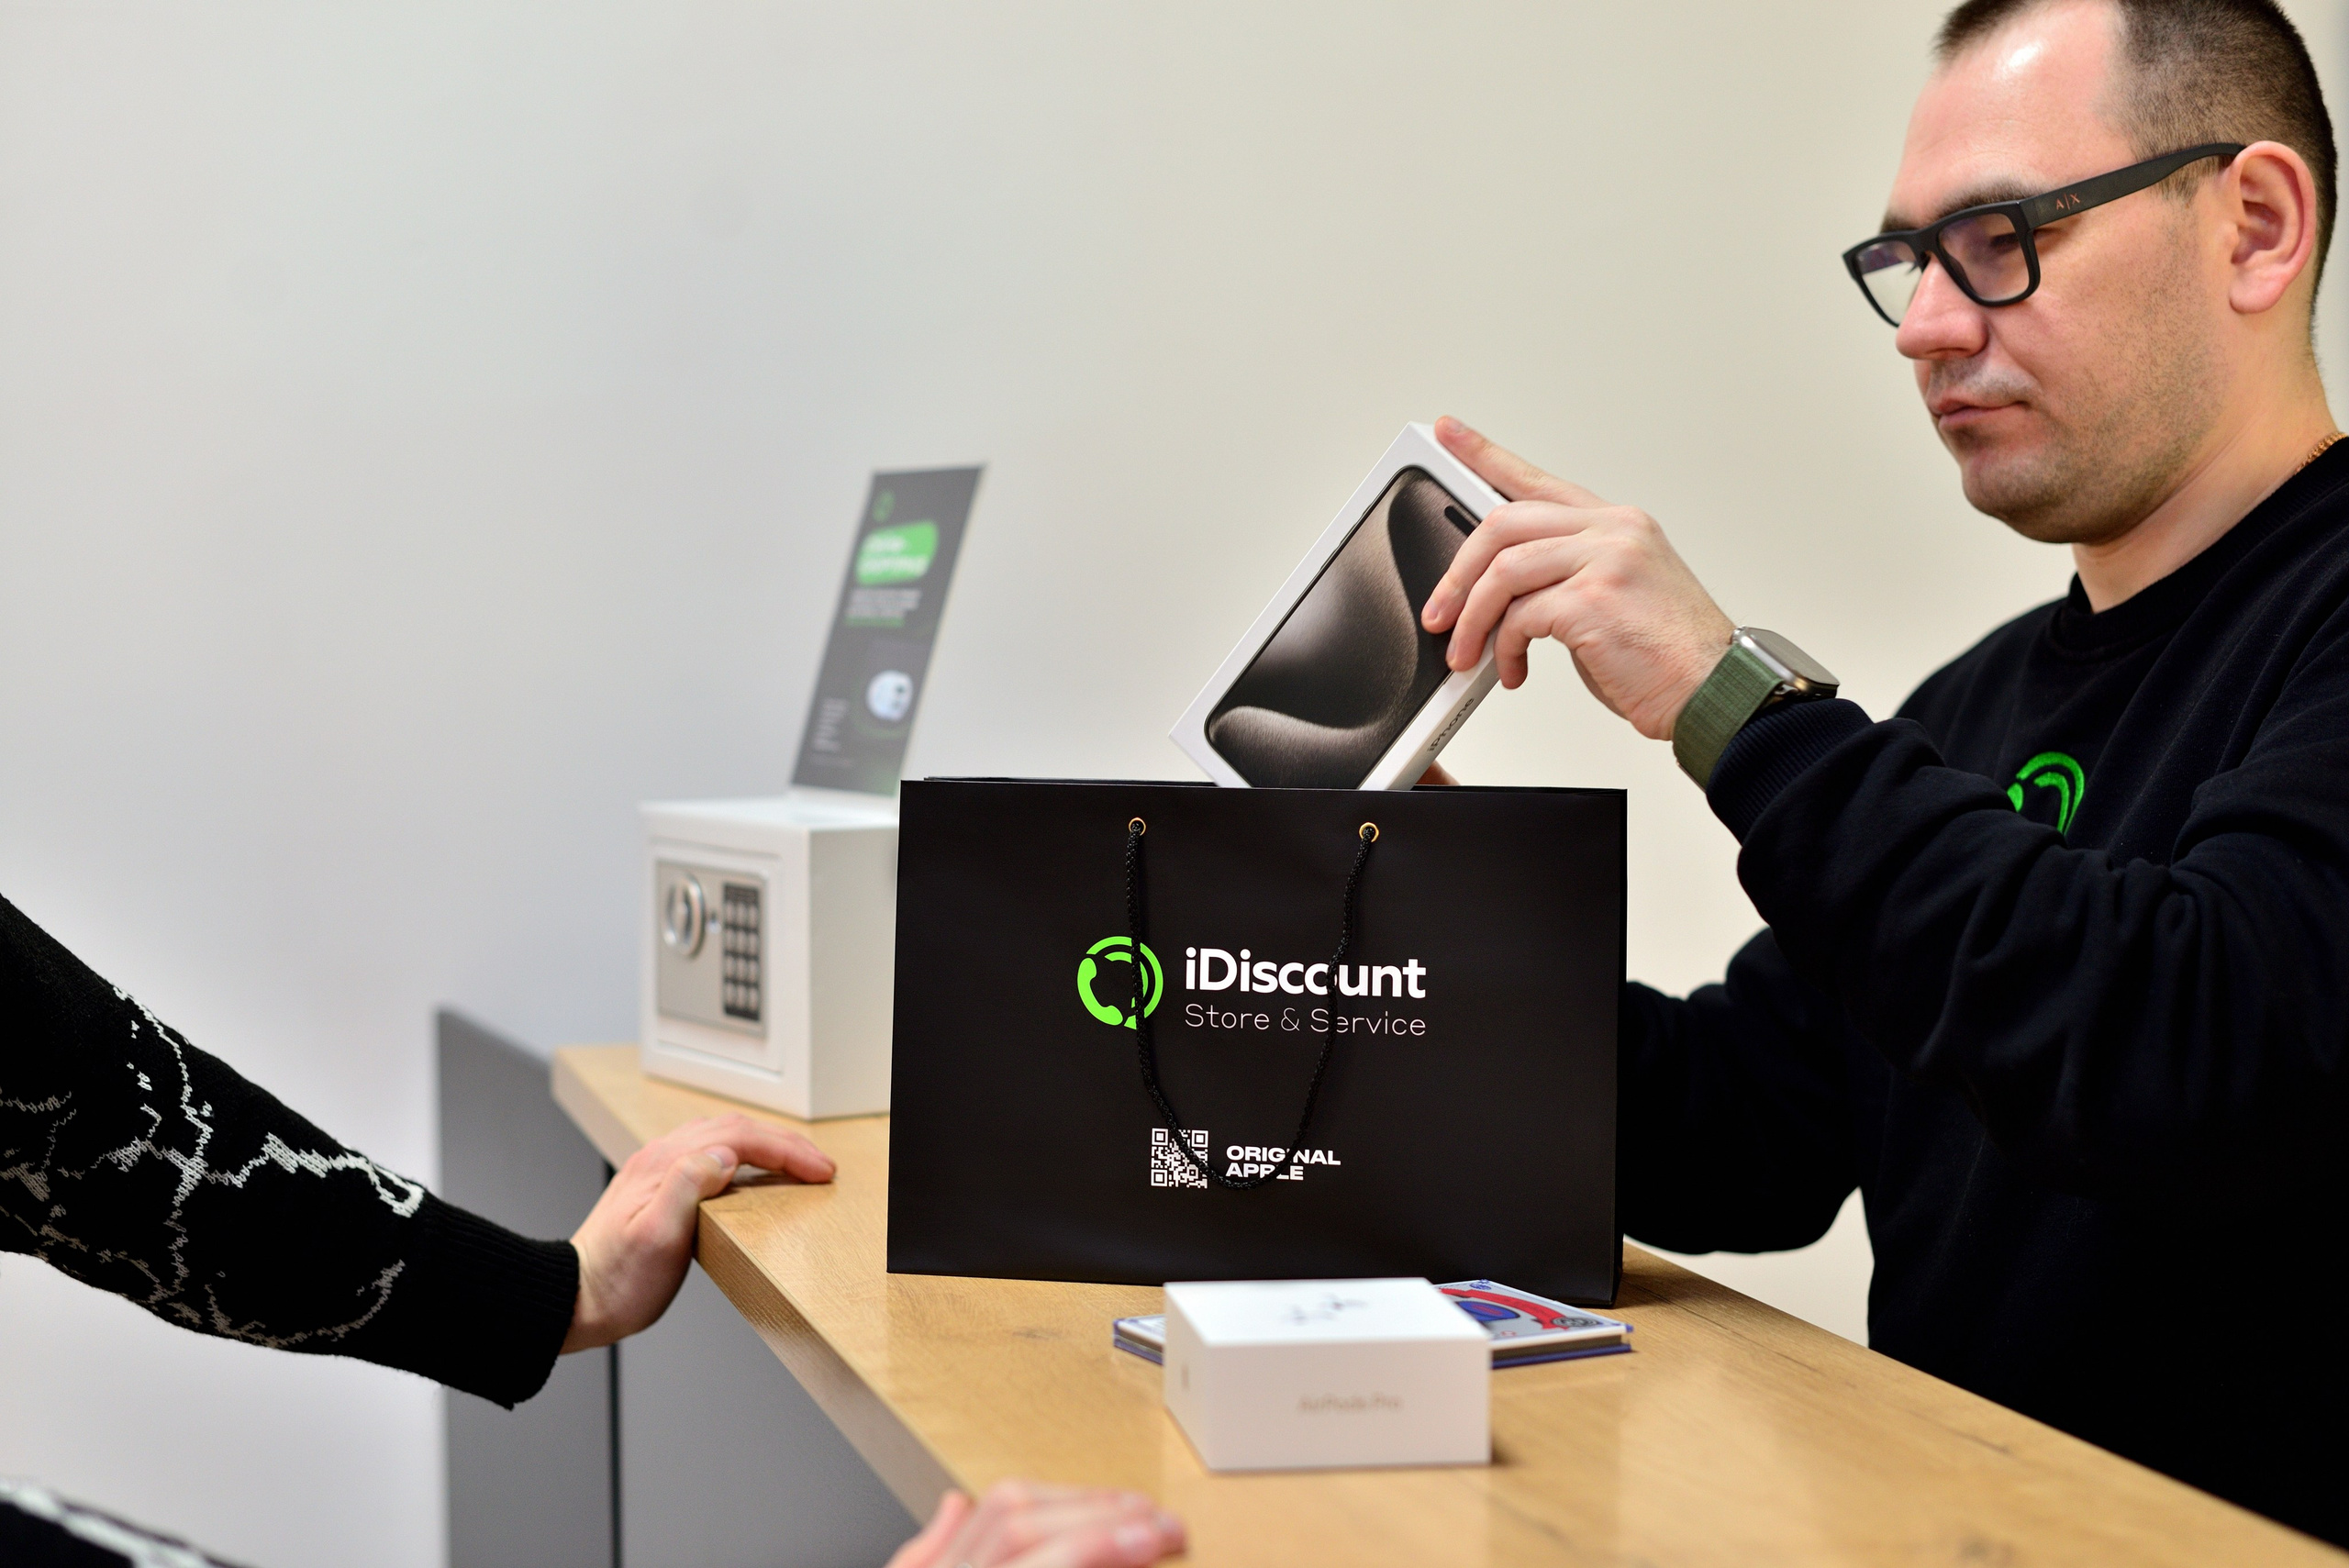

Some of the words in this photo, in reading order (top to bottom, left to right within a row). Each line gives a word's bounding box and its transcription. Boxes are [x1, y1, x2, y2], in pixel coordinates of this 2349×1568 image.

[1427, 698, 1474, 751] iPhone
[1186, 946, 1427, 999] iDiscount
[1185, 1003, 1270, 1030] Store
[1280, 1007, 1300, 1031] &
[1310, 1008, 1426, 1036] Service
[1226, 1145, 1341, 1165] ORIGNAL
